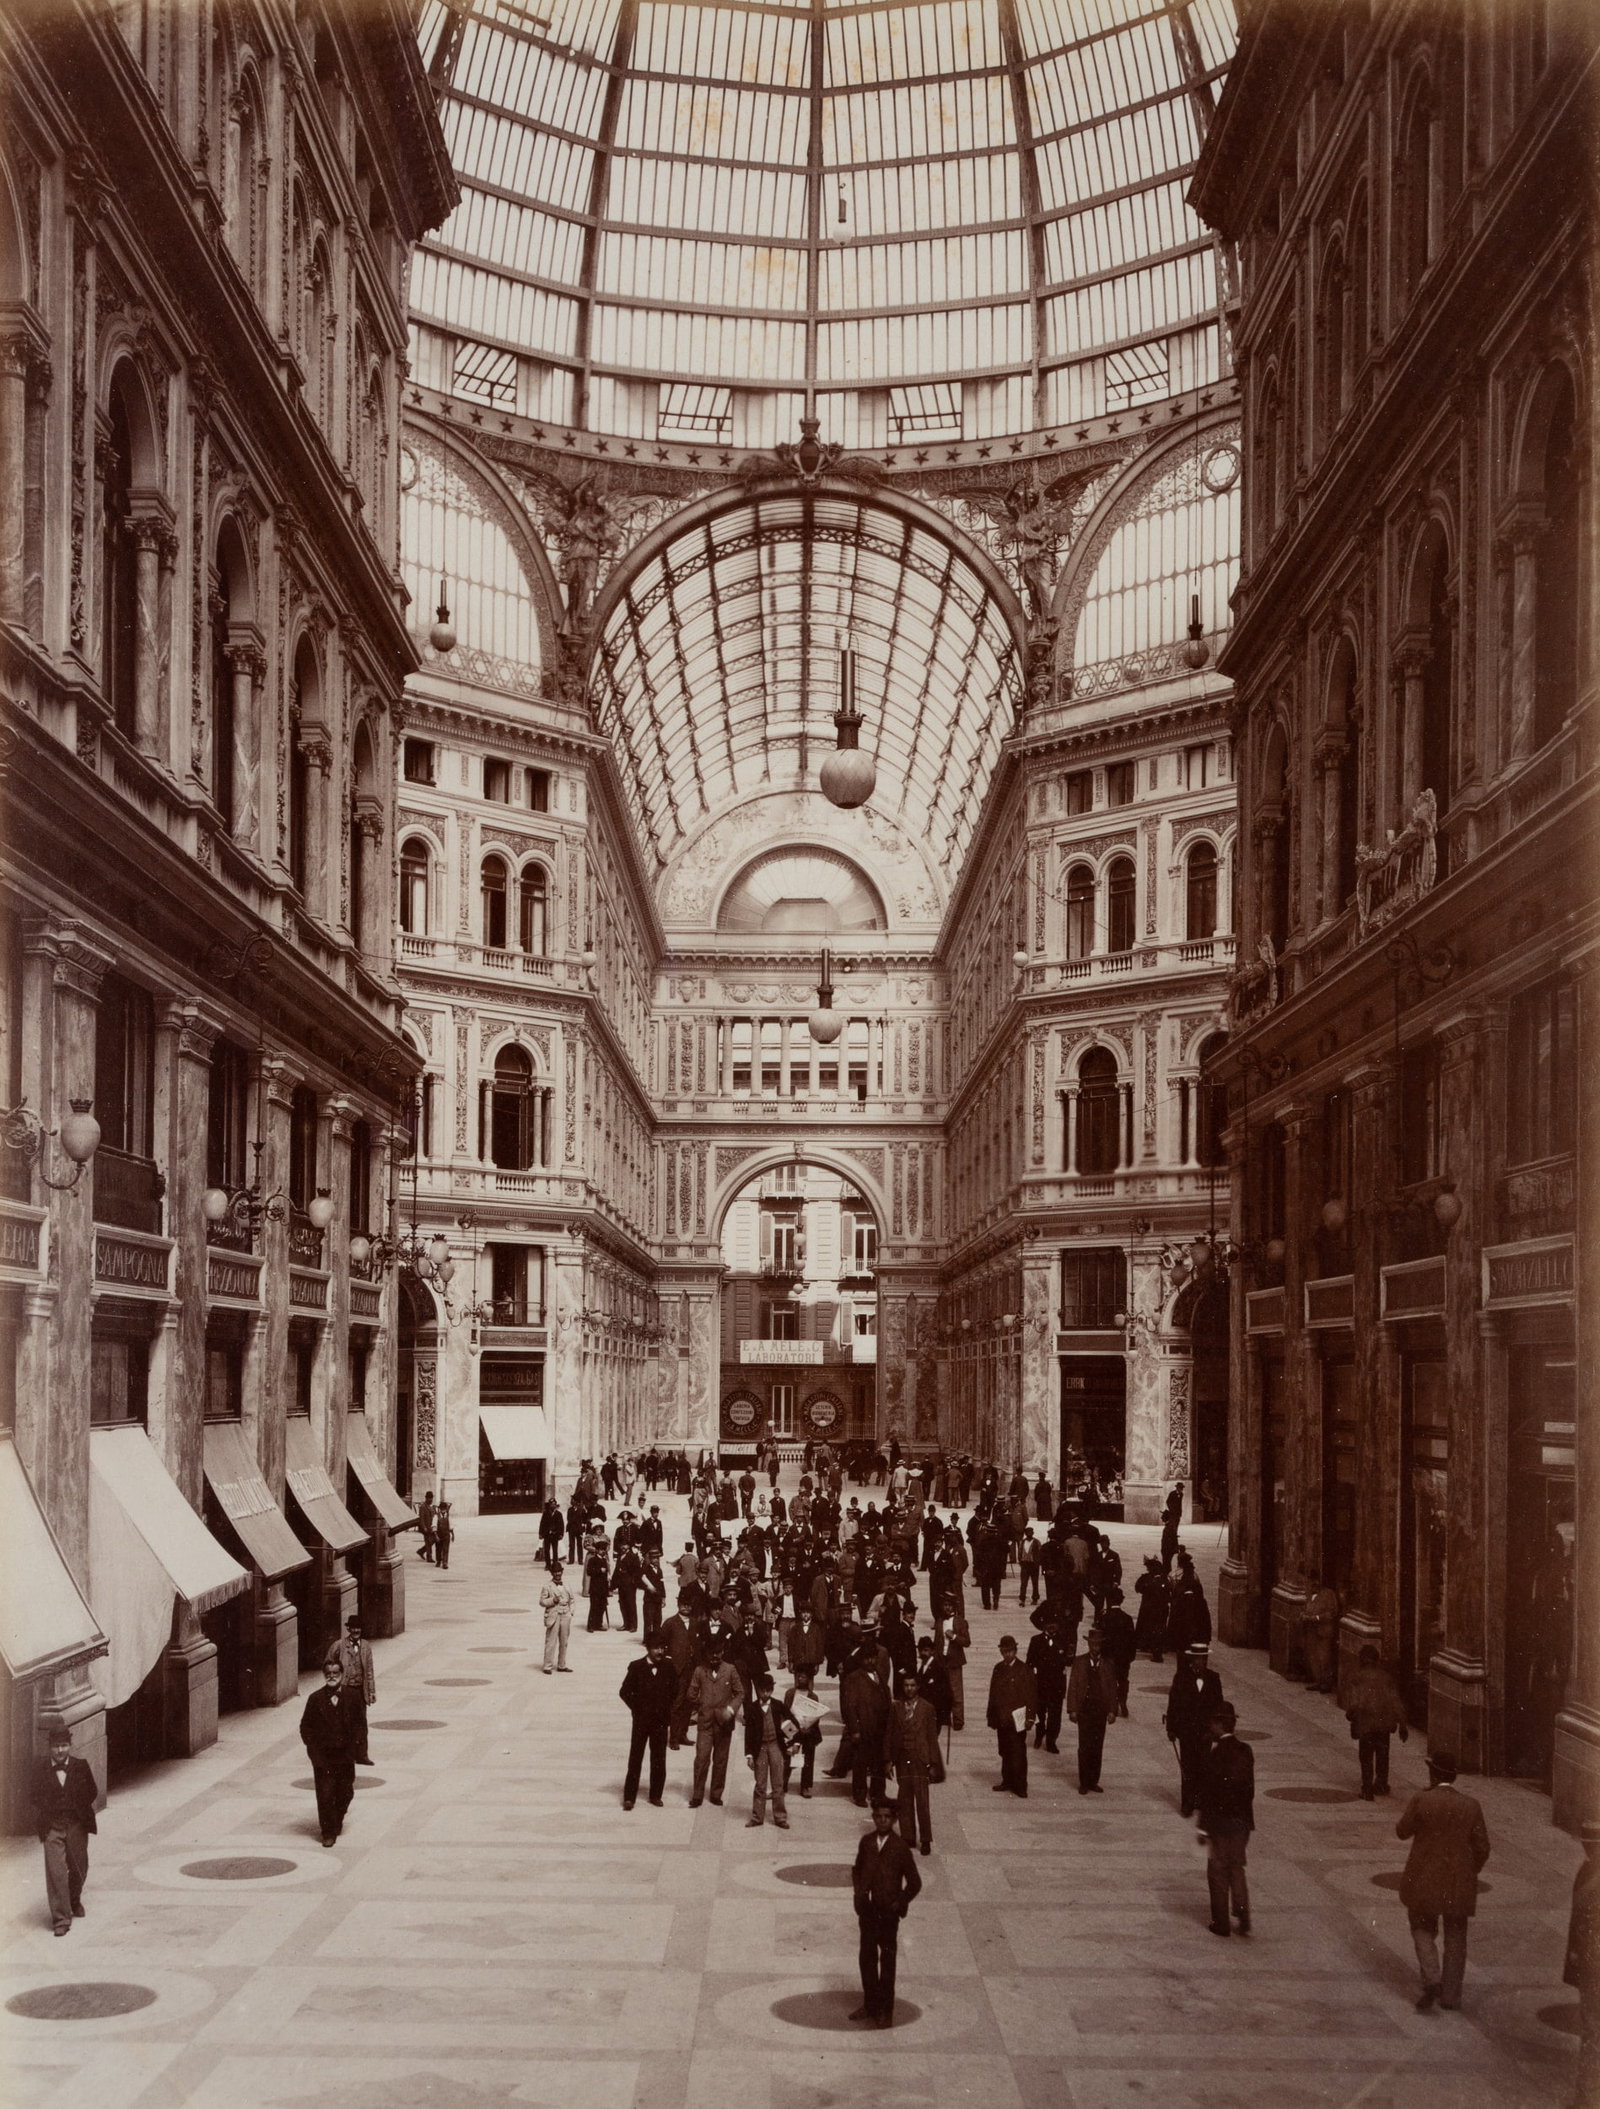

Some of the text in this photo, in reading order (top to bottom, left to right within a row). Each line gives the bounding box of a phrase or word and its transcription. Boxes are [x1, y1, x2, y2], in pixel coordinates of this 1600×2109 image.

[96, 1243, 165, 1284] SAMPOGNA
[770, 1340, 805, 1352] MELE
[748, 1352, 817, 1363] LABORATORI
